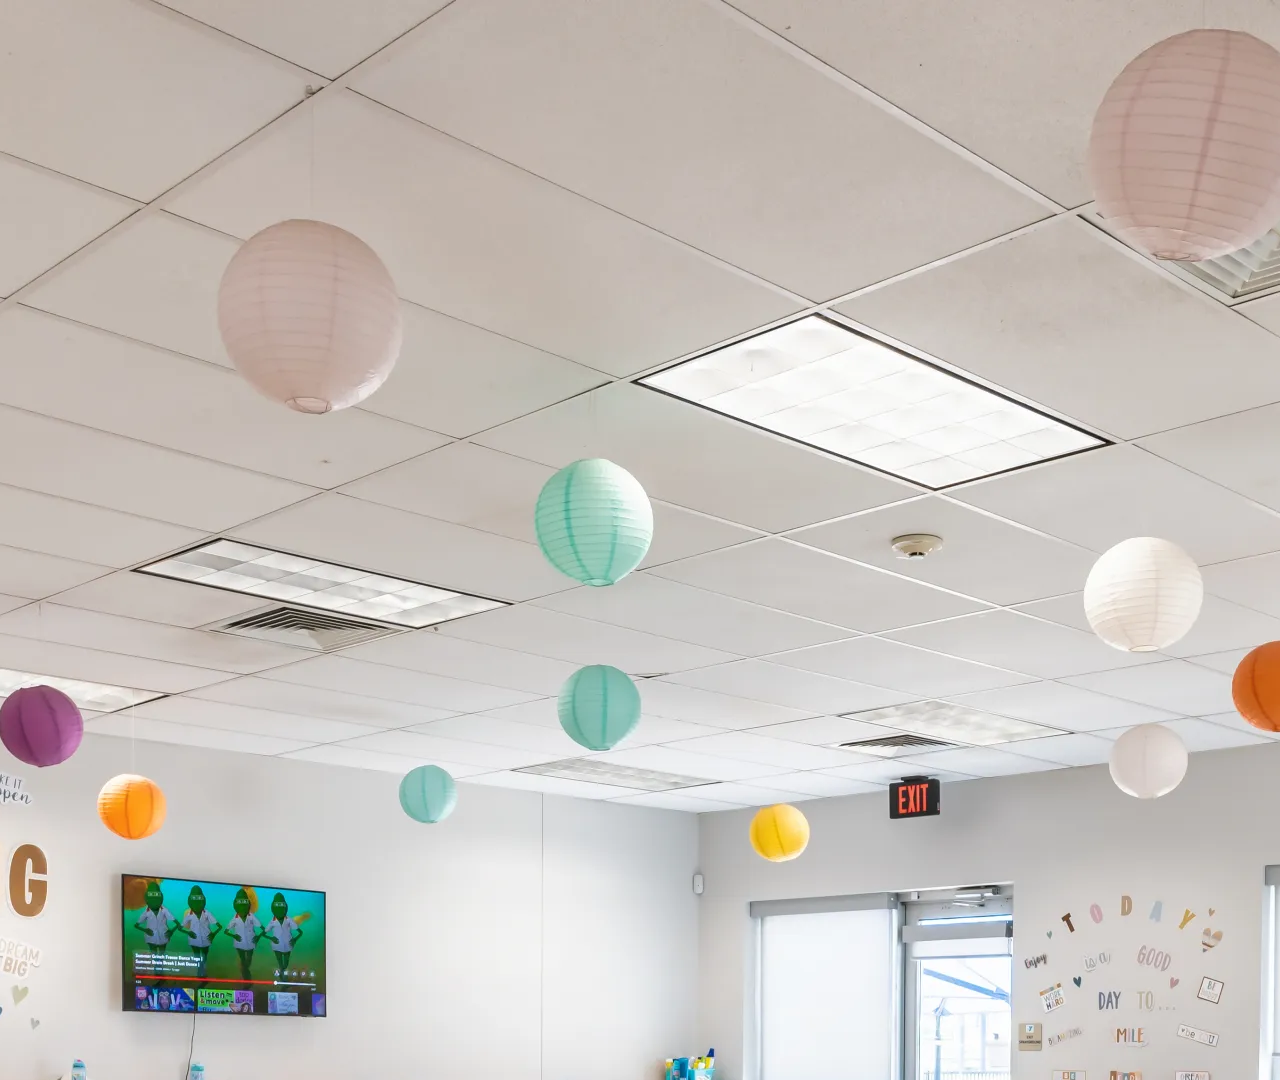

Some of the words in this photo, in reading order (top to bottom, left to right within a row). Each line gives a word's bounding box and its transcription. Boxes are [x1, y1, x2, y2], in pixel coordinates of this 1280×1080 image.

[13, 777, 23, 789] IT
[898, 783, 929, 814] EXIT
[1061, 895, 1197, 933] TODAY
[1024, 953, 1047, 969] Enjoy
[1137, 945, 1171, 972] GOOD
[3, 957, 28, 977] BIG
[200, 991, 225, 999] Listen
[1043, 990, 1062, 1003] WORK
[1098, 991, 1122, 1010] DAY
[1046, 997, 1064, 1011] HARD
[1111, 1027, 1145, 1043] MILE
[1185, 1028, 1196, 1039] be
[1180, 1073, 1206, 1080] DREAM
